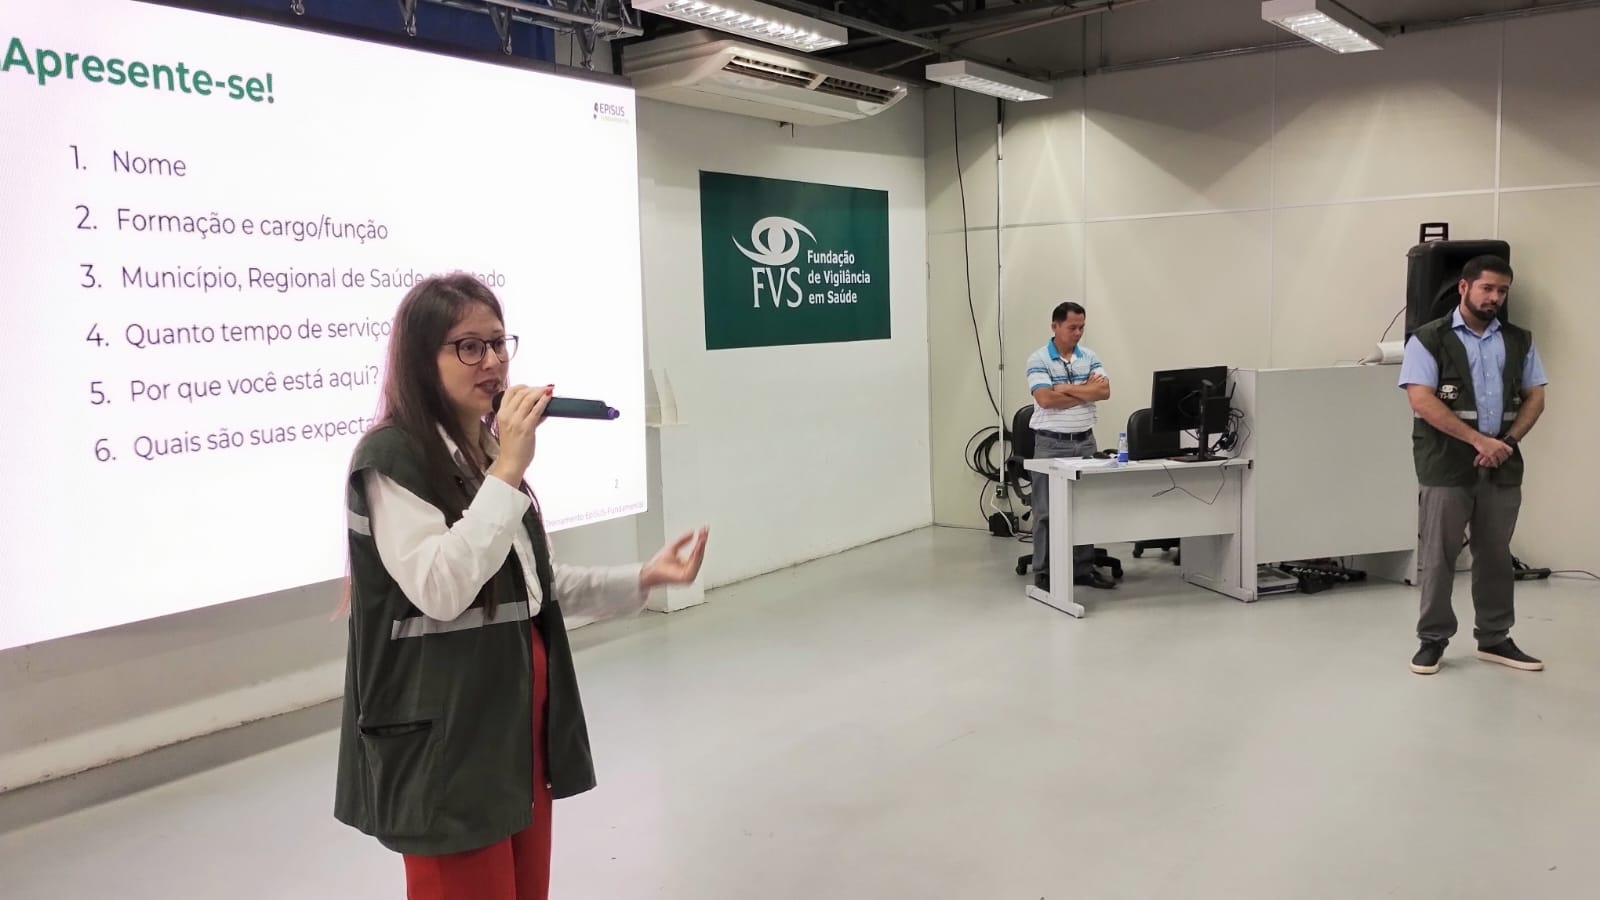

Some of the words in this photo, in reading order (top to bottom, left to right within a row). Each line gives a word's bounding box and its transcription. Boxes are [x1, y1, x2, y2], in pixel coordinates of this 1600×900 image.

[1, 37, 275, 104] Apresente-se!
[599, 103, 625, 117] EPISUS
[69, 145, 87, 170] 1.
[113, 150, 187, 177] Nome
[75, 205, 97, 230] 2.
[117, 208, 236, 239] Formação
[242, 218, 254, 235] e
[260, 214, 388, 244] cargo/função
[807, 249, 855, 267] Fundação
[80, 264, 102, 289] 3.
[121, 265, 242, 293] Município,
[248, 266, 336, 293] Regional
[341, 268, 365, 288] de
[370, 268, 424, 288] Saúde
[752, 266, 803, 308] FVS
[808, 269, 821, 284] de
[823, 268, 871, 287] Vigilância
[808, 291, 825, 304] em
[827, 288, 858, 304] Saúde
[85, 323, 110, 347] 4.
[125, 323, 215, 349] Quanto
[222, 323, 292, 346] tempo
[297, 318, 322, 339] de
[327, 316, 394, 341] serviço
[90, 381, 111, 405] 5.
[130, 380, 170, 402] Por
[177, 379, 221, 404] que
[227, 371, 277, 394] você
[283, 368, 323, 391] está
[329, 365, 379, 391] aqui?
[95, 438, 116, 462] 6.
[134, 431, 201, 461] Quais
[207, 428, 244, 450] são
[250, 425, 296, 445] suas
[302, 416, 376, 442] expecta
